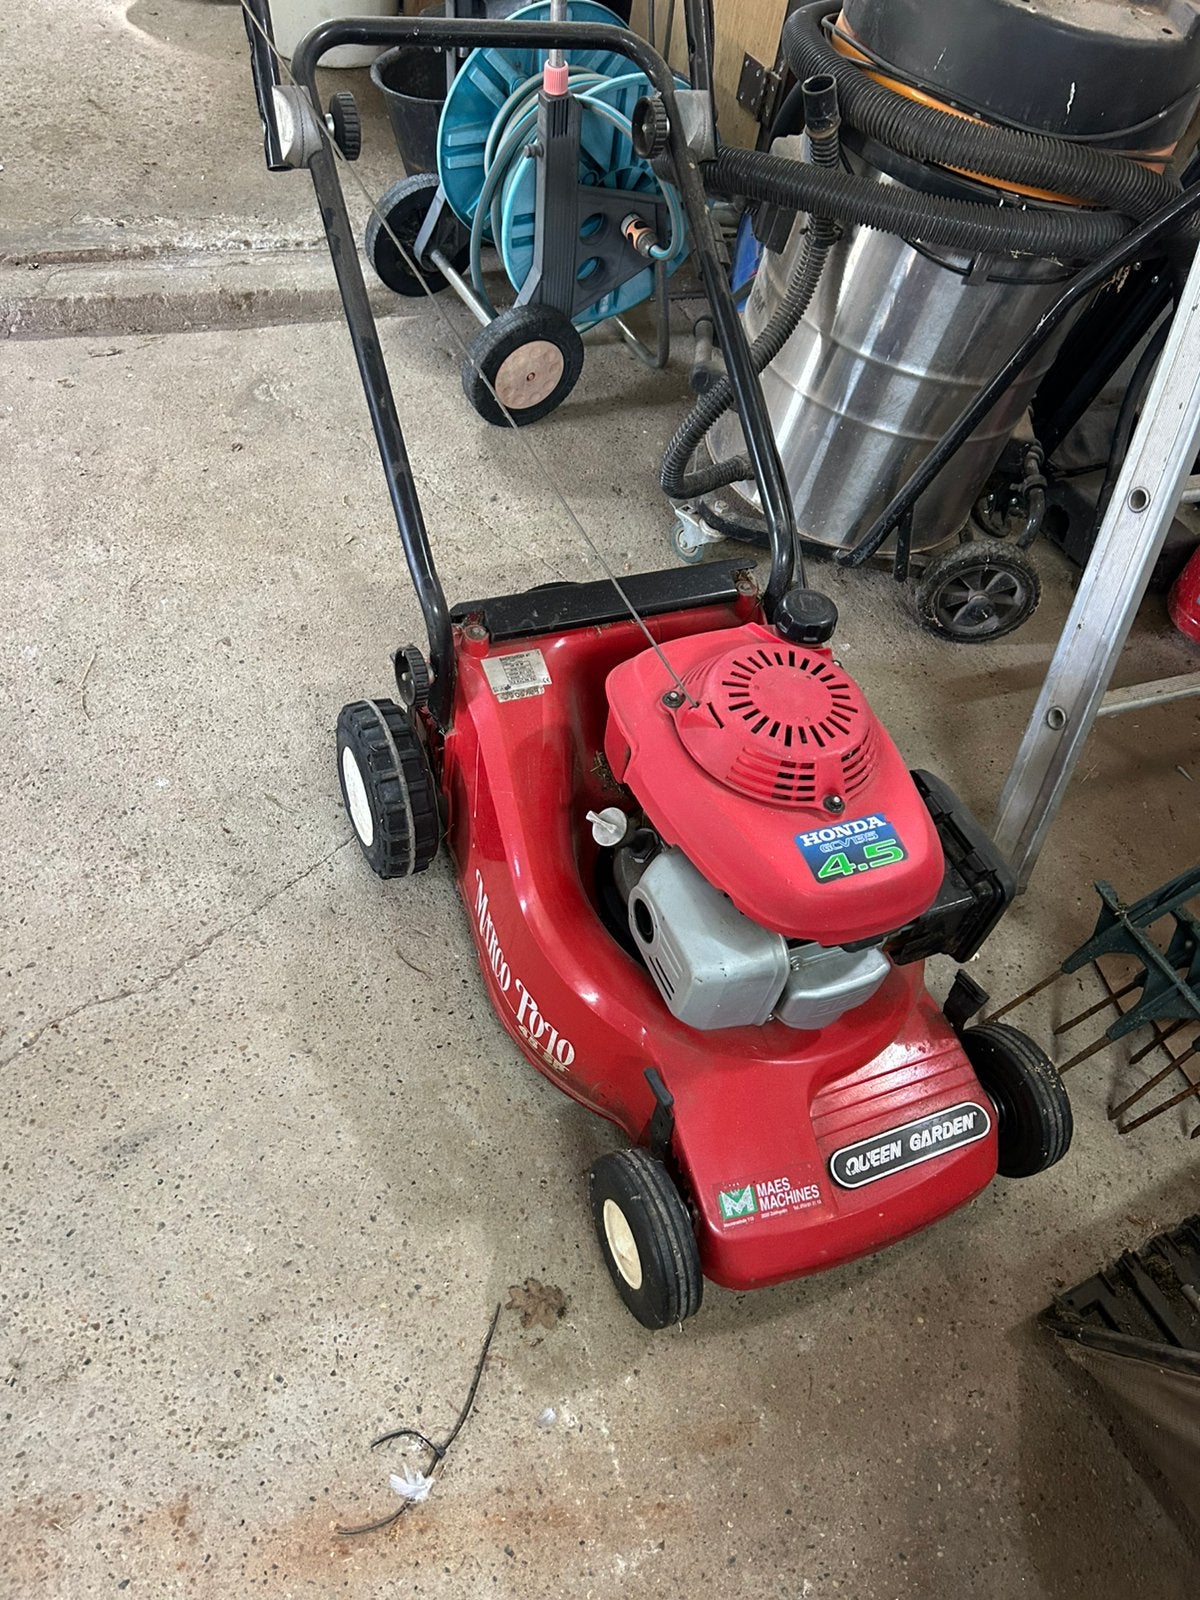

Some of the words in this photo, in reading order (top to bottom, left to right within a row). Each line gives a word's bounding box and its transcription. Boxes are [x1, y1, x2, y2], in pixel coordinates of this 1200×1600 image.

[800, 815, 887, 847] HONDA
[818, 838, 904, 878] 4.5
[845, 1140, 902, 1176] QUEEN
[909, 1113, 975, 1151] GARDEN
[756, 1177, 791, 1198] MAES
[759, 1185, 820, 1212] MACHINES
